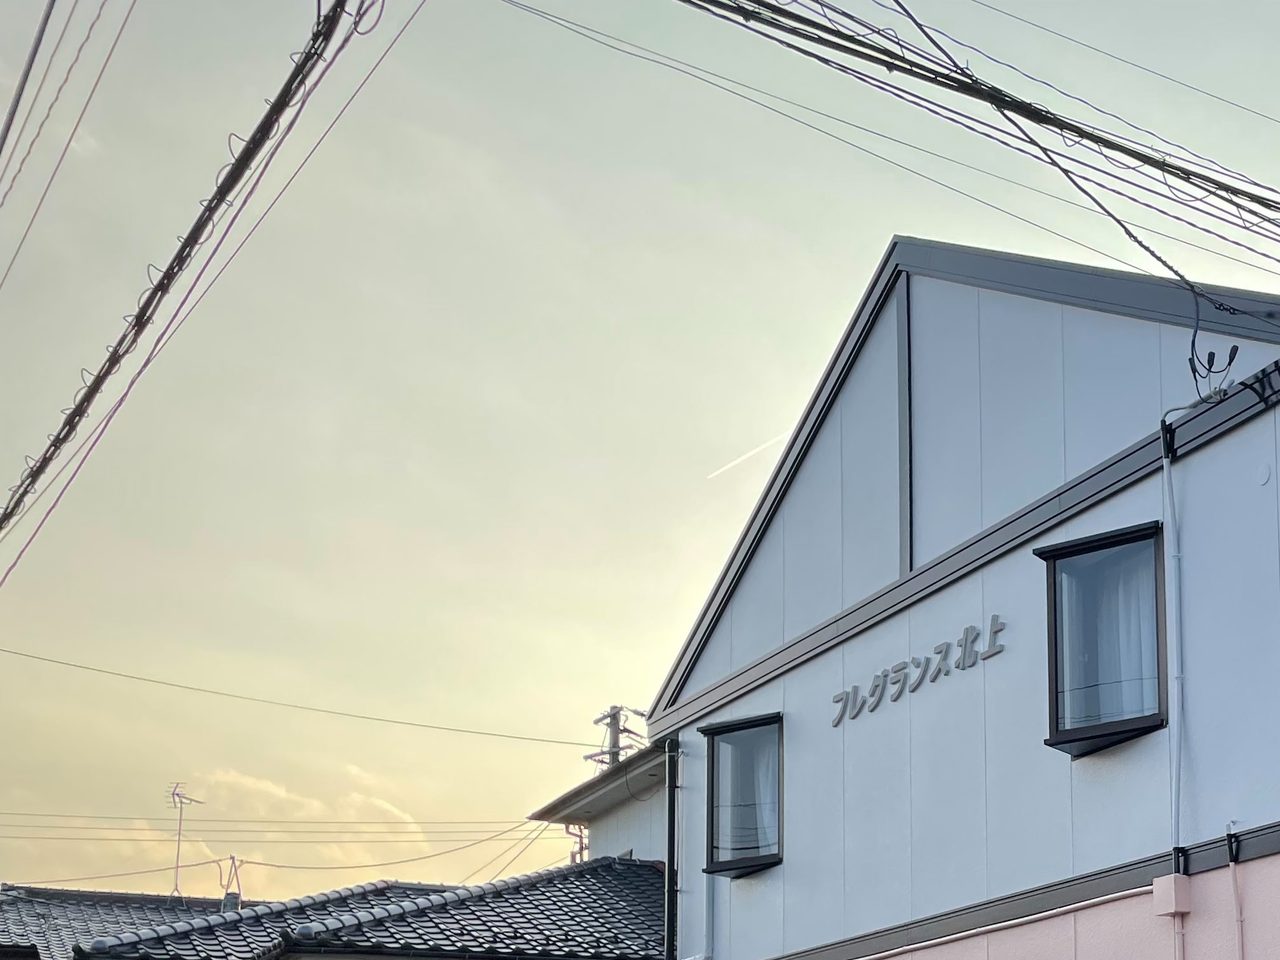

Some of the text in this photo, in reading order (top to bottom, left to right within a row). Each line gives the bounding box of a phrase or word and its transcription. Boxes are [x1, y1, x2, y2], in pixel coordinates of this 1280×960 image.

[832, 614, 1006, 728] フレグランス北上
